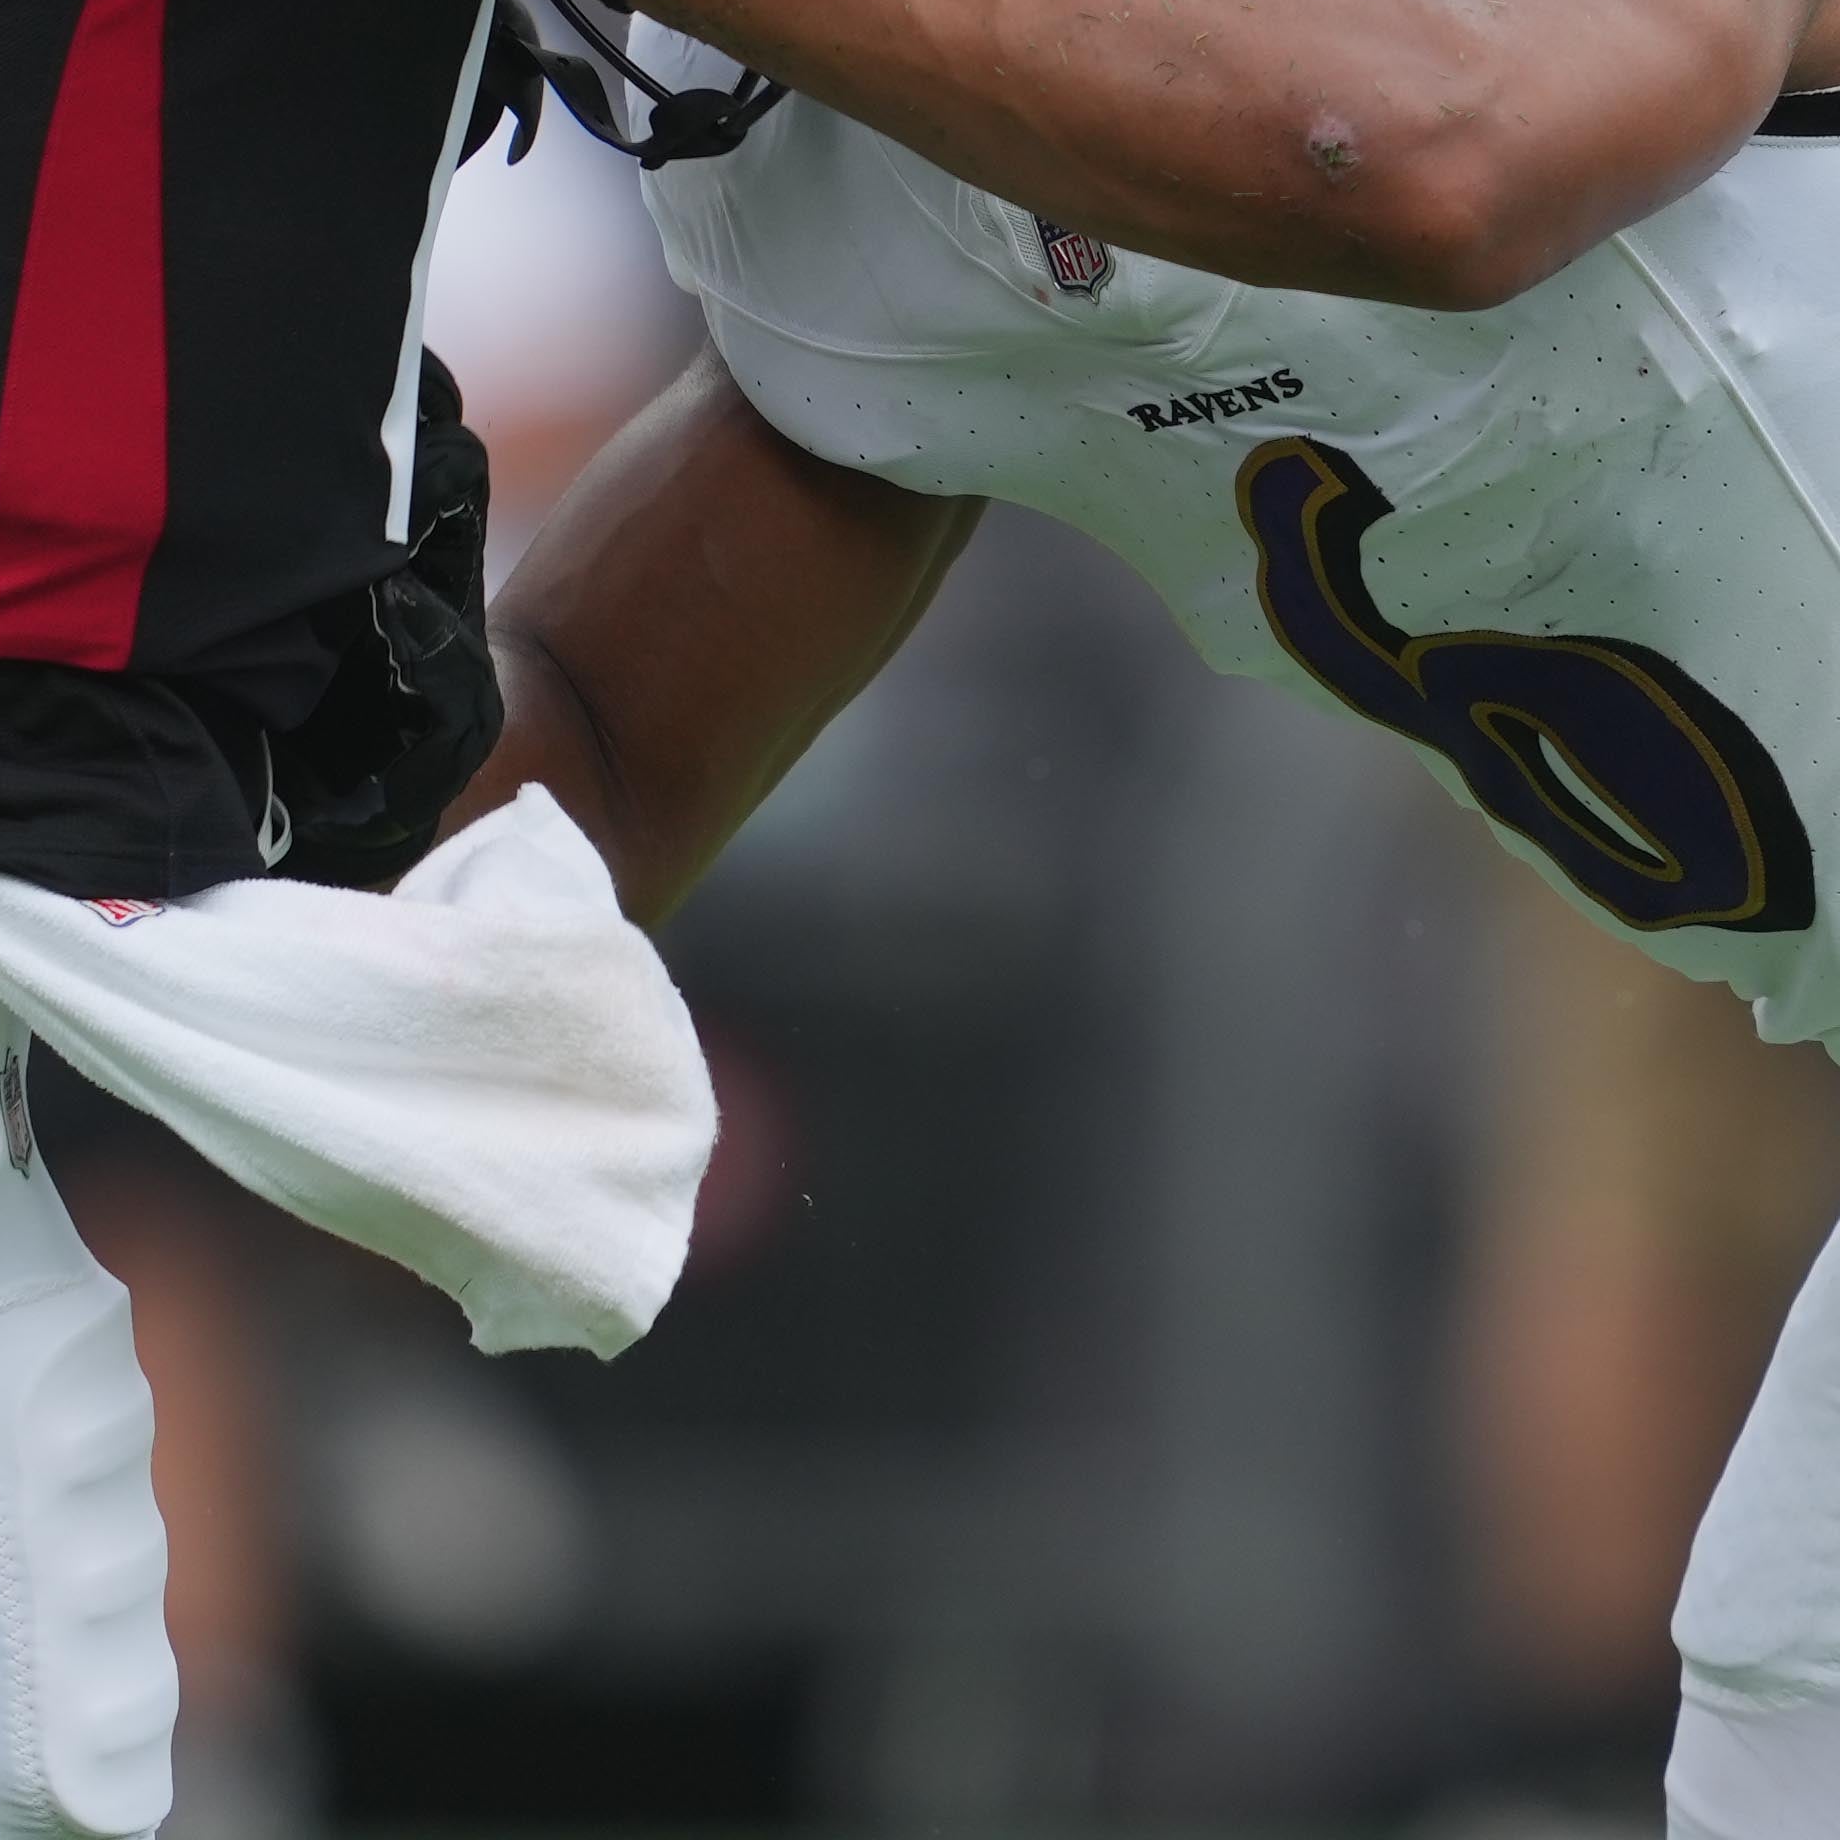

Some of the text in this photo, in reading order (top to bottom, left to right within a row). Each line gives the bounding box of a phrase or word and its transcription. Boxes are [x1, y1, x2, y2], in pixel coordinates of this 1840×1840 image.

[1051, 234, 1103, 281] NFL
[1126, 367, 1305, 433] RAVENS
[1234, 434, 1816, 933] 6
